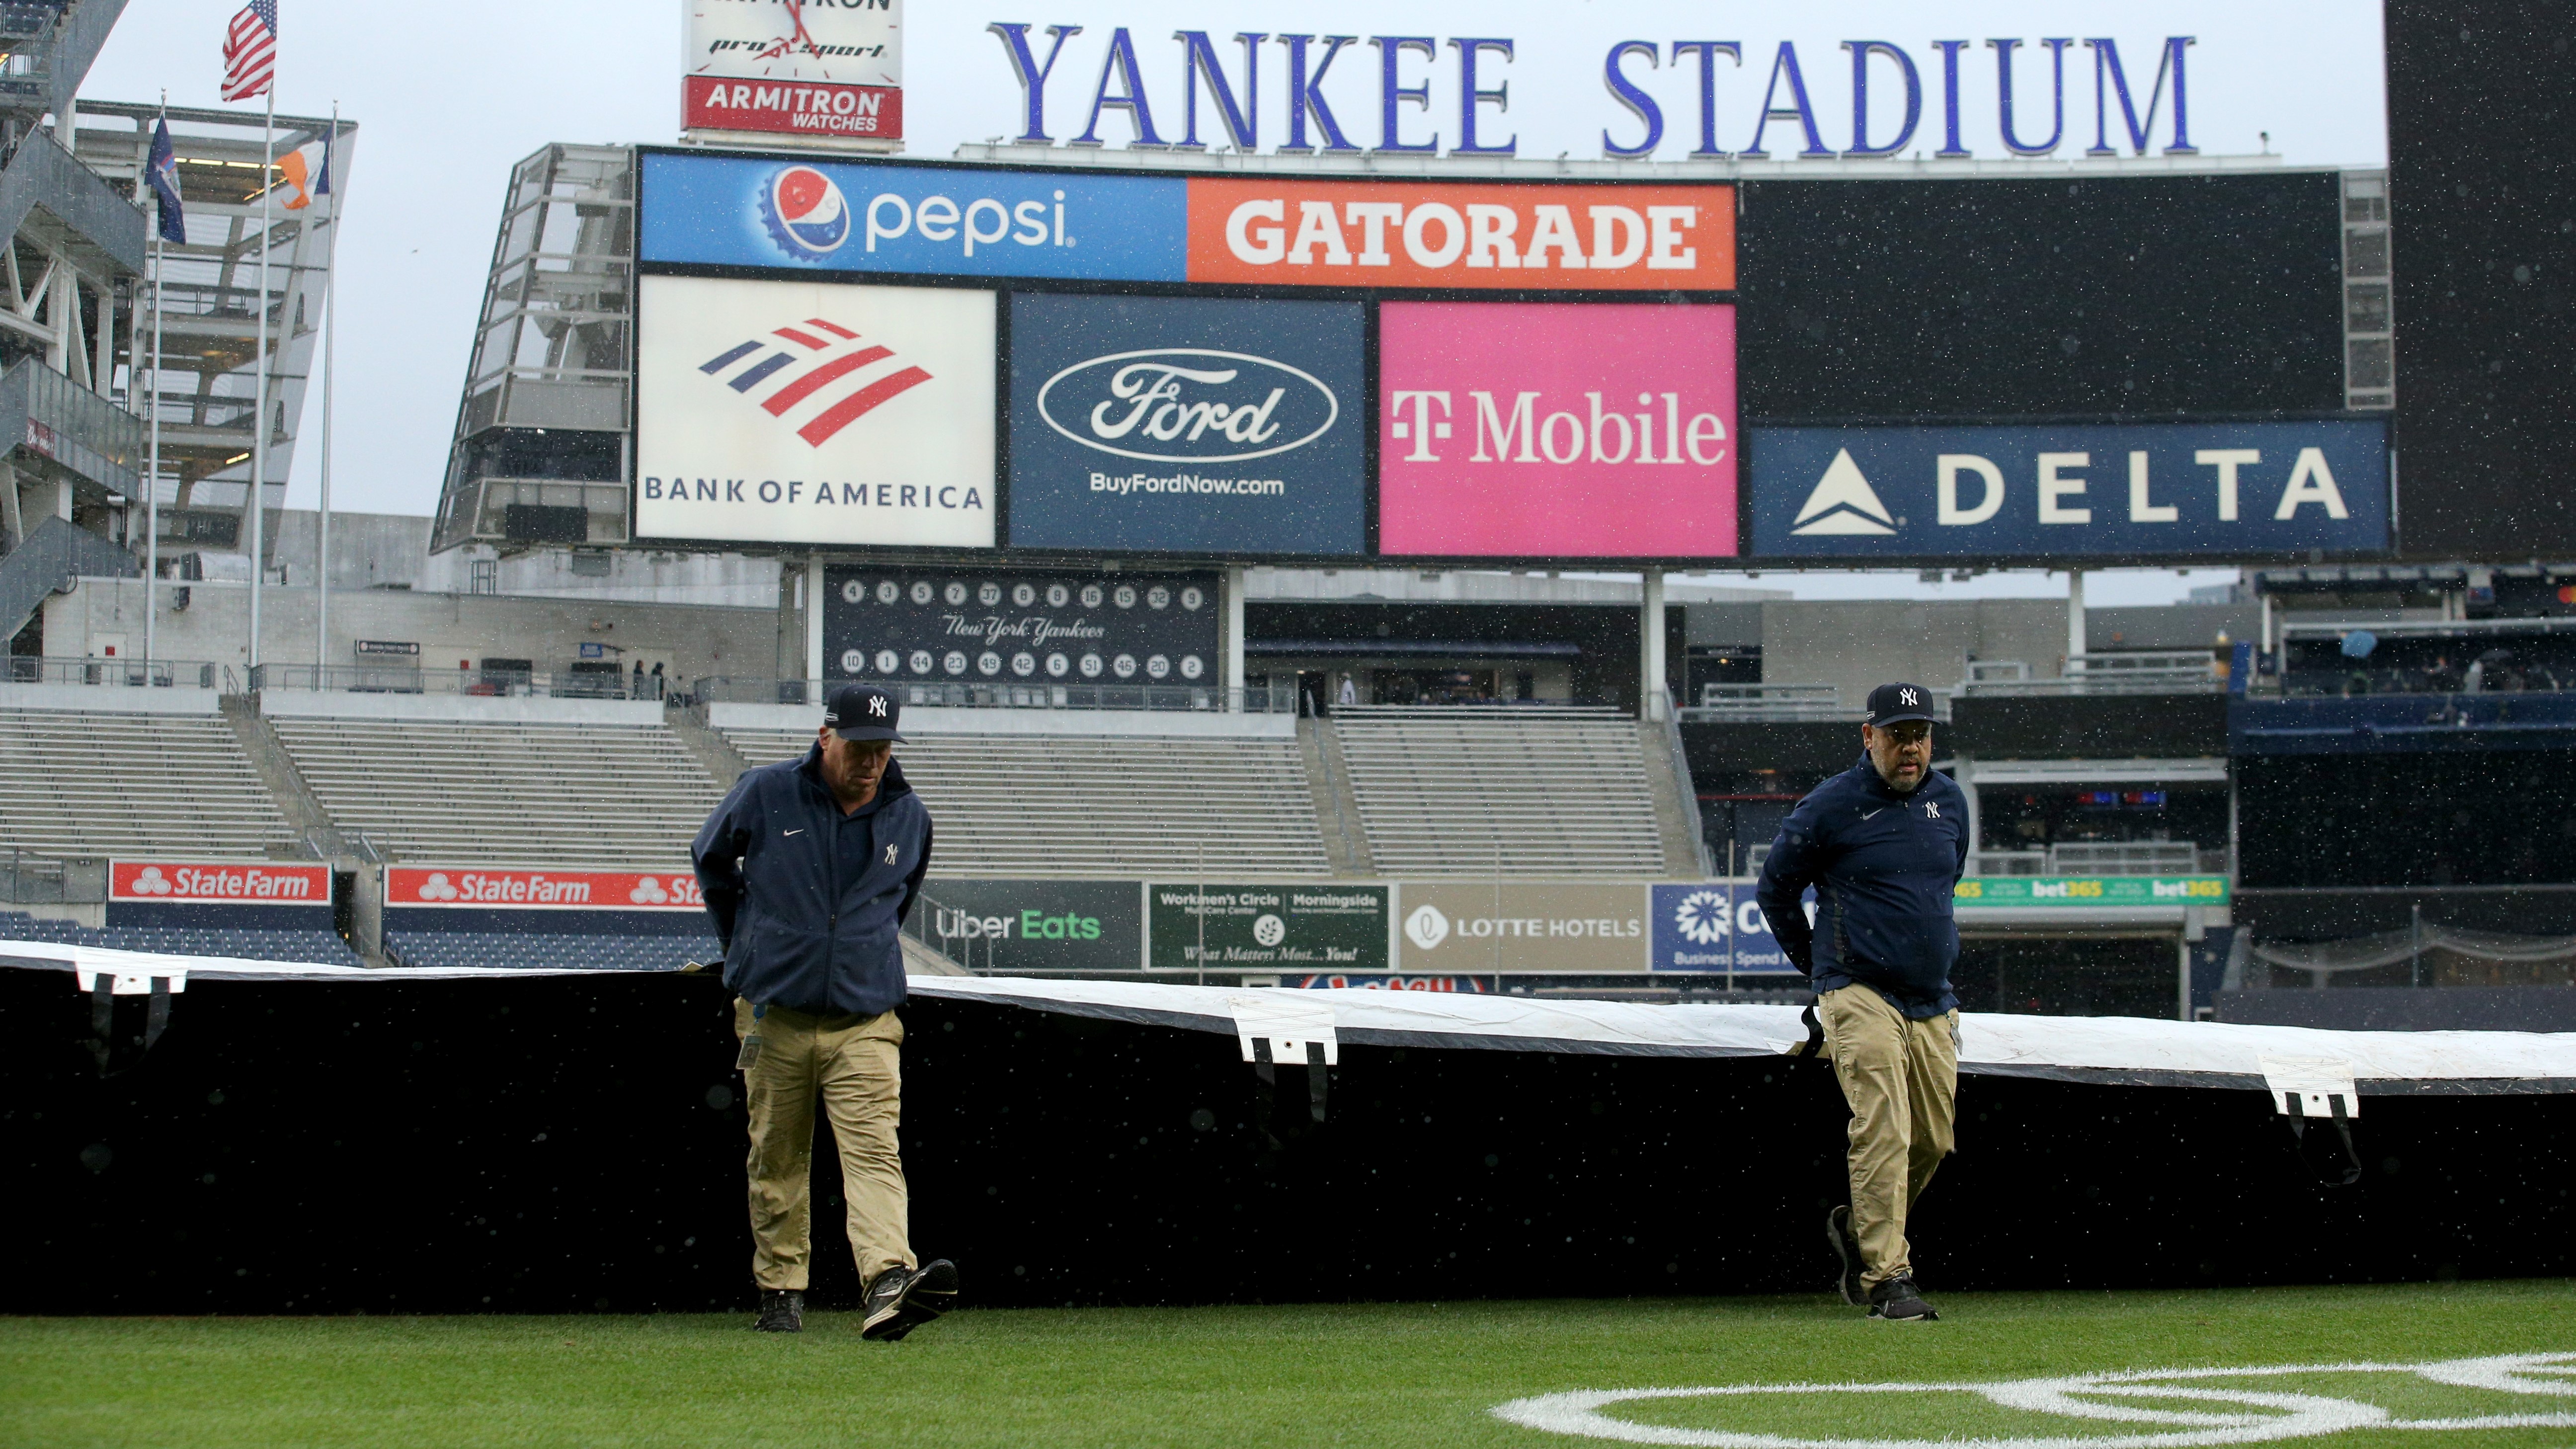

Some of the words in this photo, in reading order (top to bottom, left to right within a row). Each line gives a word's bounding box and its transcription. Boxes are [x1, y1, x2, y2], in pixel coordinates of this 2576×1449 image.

[706, 84, 882, 116] ARMITRON
[987, 21, 1517, 158] YANKEE
[1602, 36, 2198, 159] STADIUM
[793, 113, 878, 132] WATCHES
[865, 189, 1064, 257] pepsi
[1225, 199, 1696, 269] GATORADE
[1091, 363, 1285, 443] Ford
[645, 477, 745, 502] BANK
[759, 480, 804, 503] OF
[815, 482, 983, 509] AMERICA
[1091, 473, 1284, 495] BuyFordNow.com
[1937, 447, 2349, 526] DELTA
[1119, 591, 1130, 603] 15
[942, 615, 984, 636] New
[984, 616, 1031, 645] York
[1033, 617, 1105, 646] Yankees
[847, 655, 859, 667] 10
[913, 656, 928, 668] 44
[948, 657, 962, 668] 23
[1016, 658, 1030, 669] 42
[1085, 659, 1097, 671] 51
[1151, 661, 1164, 672] 20
[869, 695, 887, 717] NY
[1900, 688, 1918, 706] NY
[1240, 893, 1280, 906] Circle
[1293, 894, 1377, 908] Morningside
[936, 909, 1015, 939] Uber
[1021, 910, 1101, 940] Eats
[1457, 918, 1542, 937] LOTTE
[1549, 919, 1640, 938] HOTELS
[1736, 951, 1779, 967] Spend
